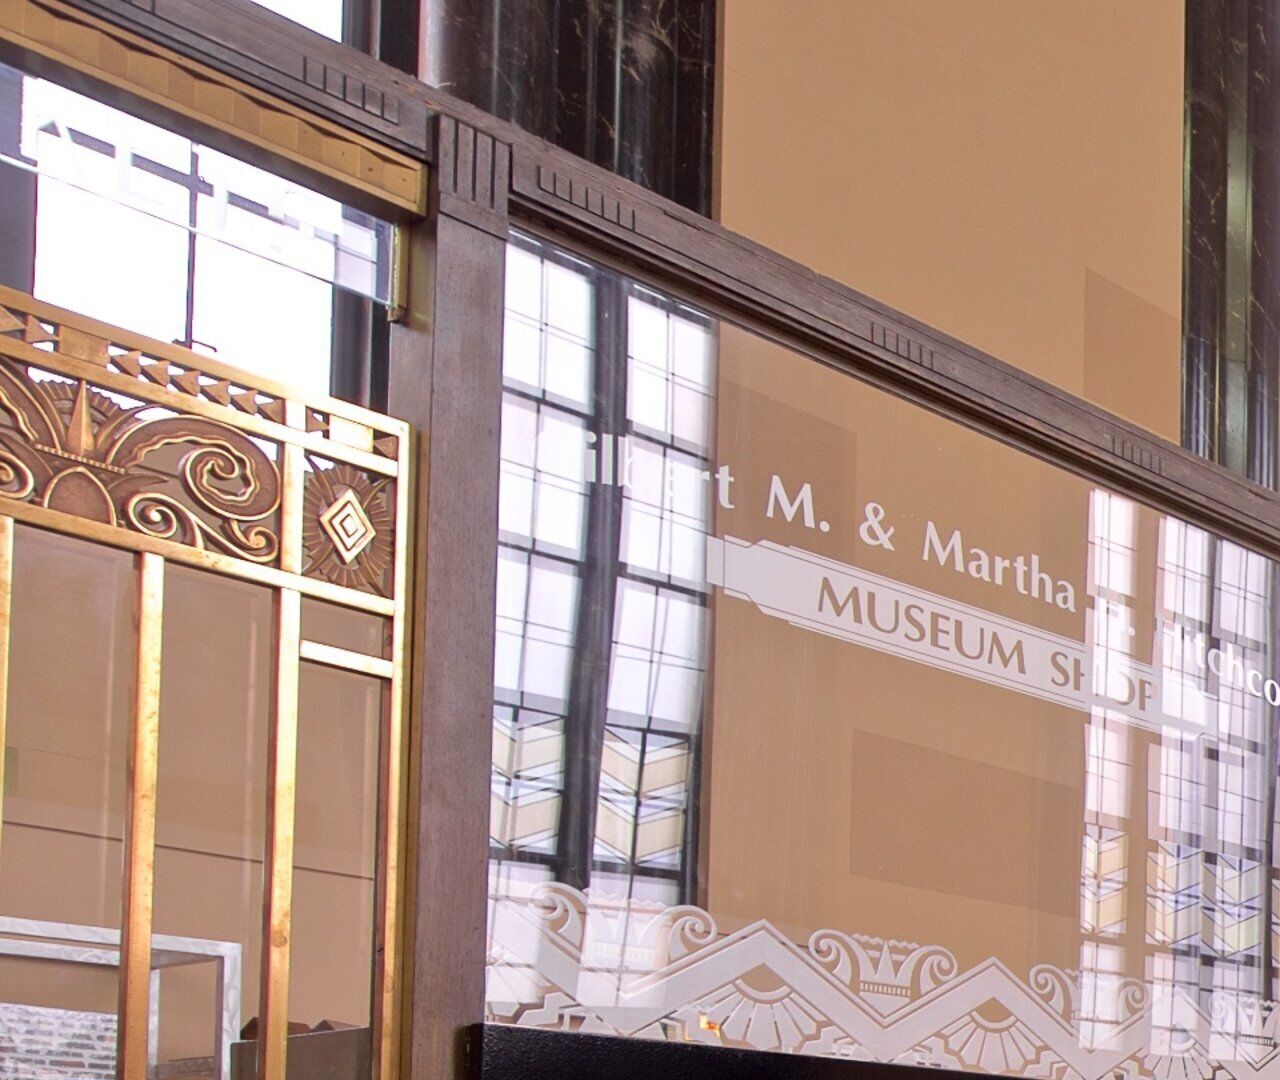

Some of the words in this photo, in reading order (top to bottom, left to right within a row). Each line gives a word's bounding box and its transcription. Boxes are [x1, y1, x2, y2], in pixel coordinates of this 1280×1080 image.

[766, 474, 831, 533] M.
[859, 502, 895, 551] &
[922, 521, 1077, 613] Martha
[816, 576, 1027, 675] MUSEUM
